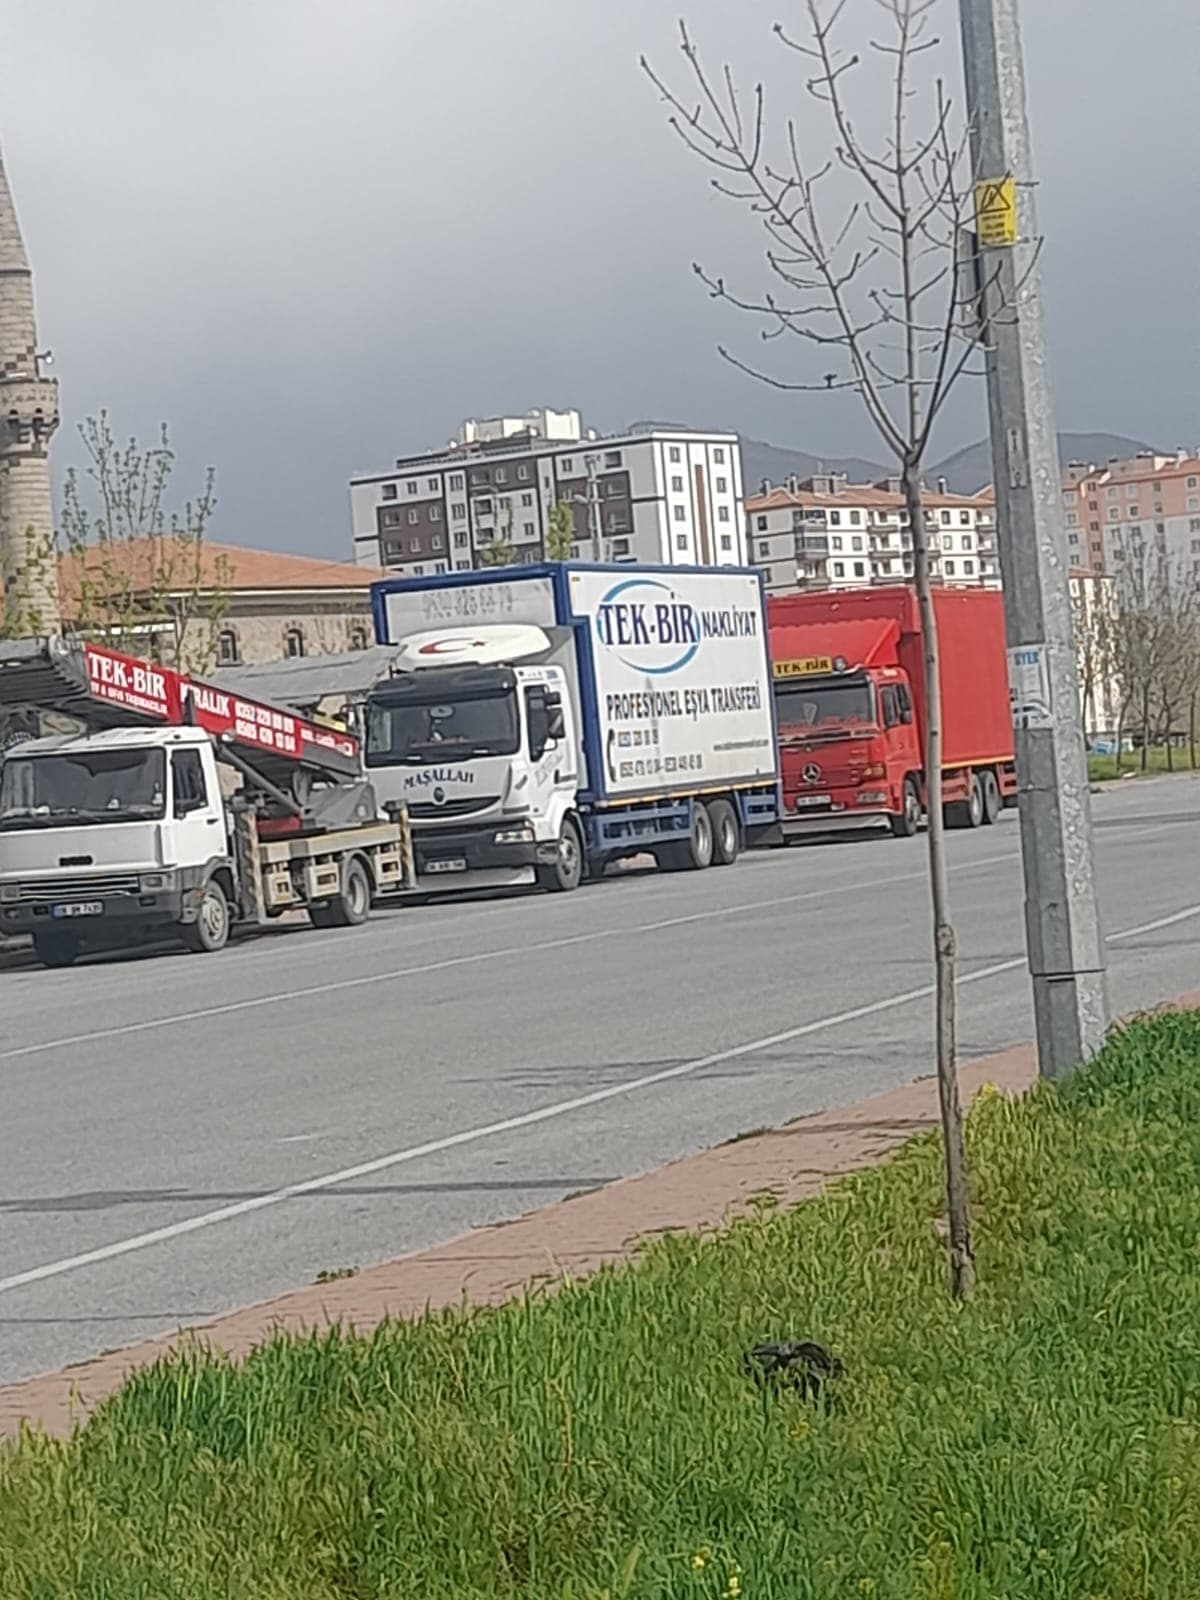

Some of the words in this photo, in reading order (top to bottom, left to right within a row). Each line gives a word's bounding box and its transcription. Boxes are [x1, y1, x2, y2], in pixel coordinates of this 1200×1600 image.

[702, 605, 756, 637] NAKLİYAT
[606, 690, 682, 721] PROFESYONEL
[685, 688, 709, 721] EŞYA
[711, 680, 761, 713] TRANSFERİ
[403, 769, 474, 790] MAŞALLAH
